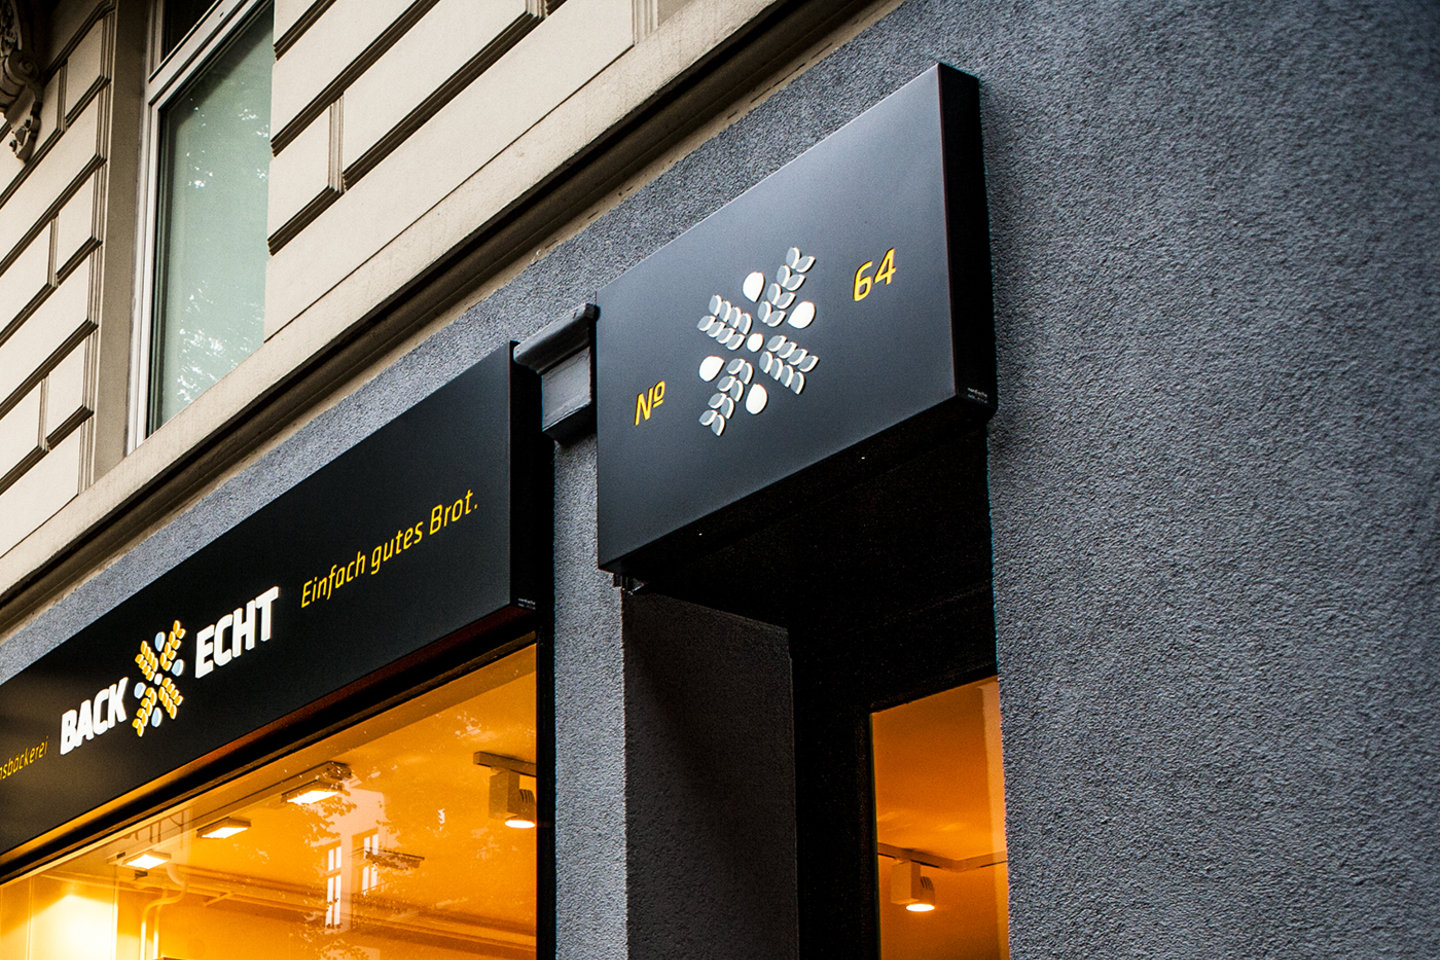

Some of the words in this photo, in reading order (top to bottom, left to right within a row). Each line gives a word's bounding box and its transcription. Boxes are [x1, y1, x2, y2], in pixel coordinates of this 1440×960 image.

[853, 247, 897, 301] 64
[60, 676, 129, 755] BACK
[195, 586, 280, 679] ECHT
[301, 553, 366, 608] Einfach
[371, 521, 423, 574] gutes
[429, 489, 479, 536] Brot.
